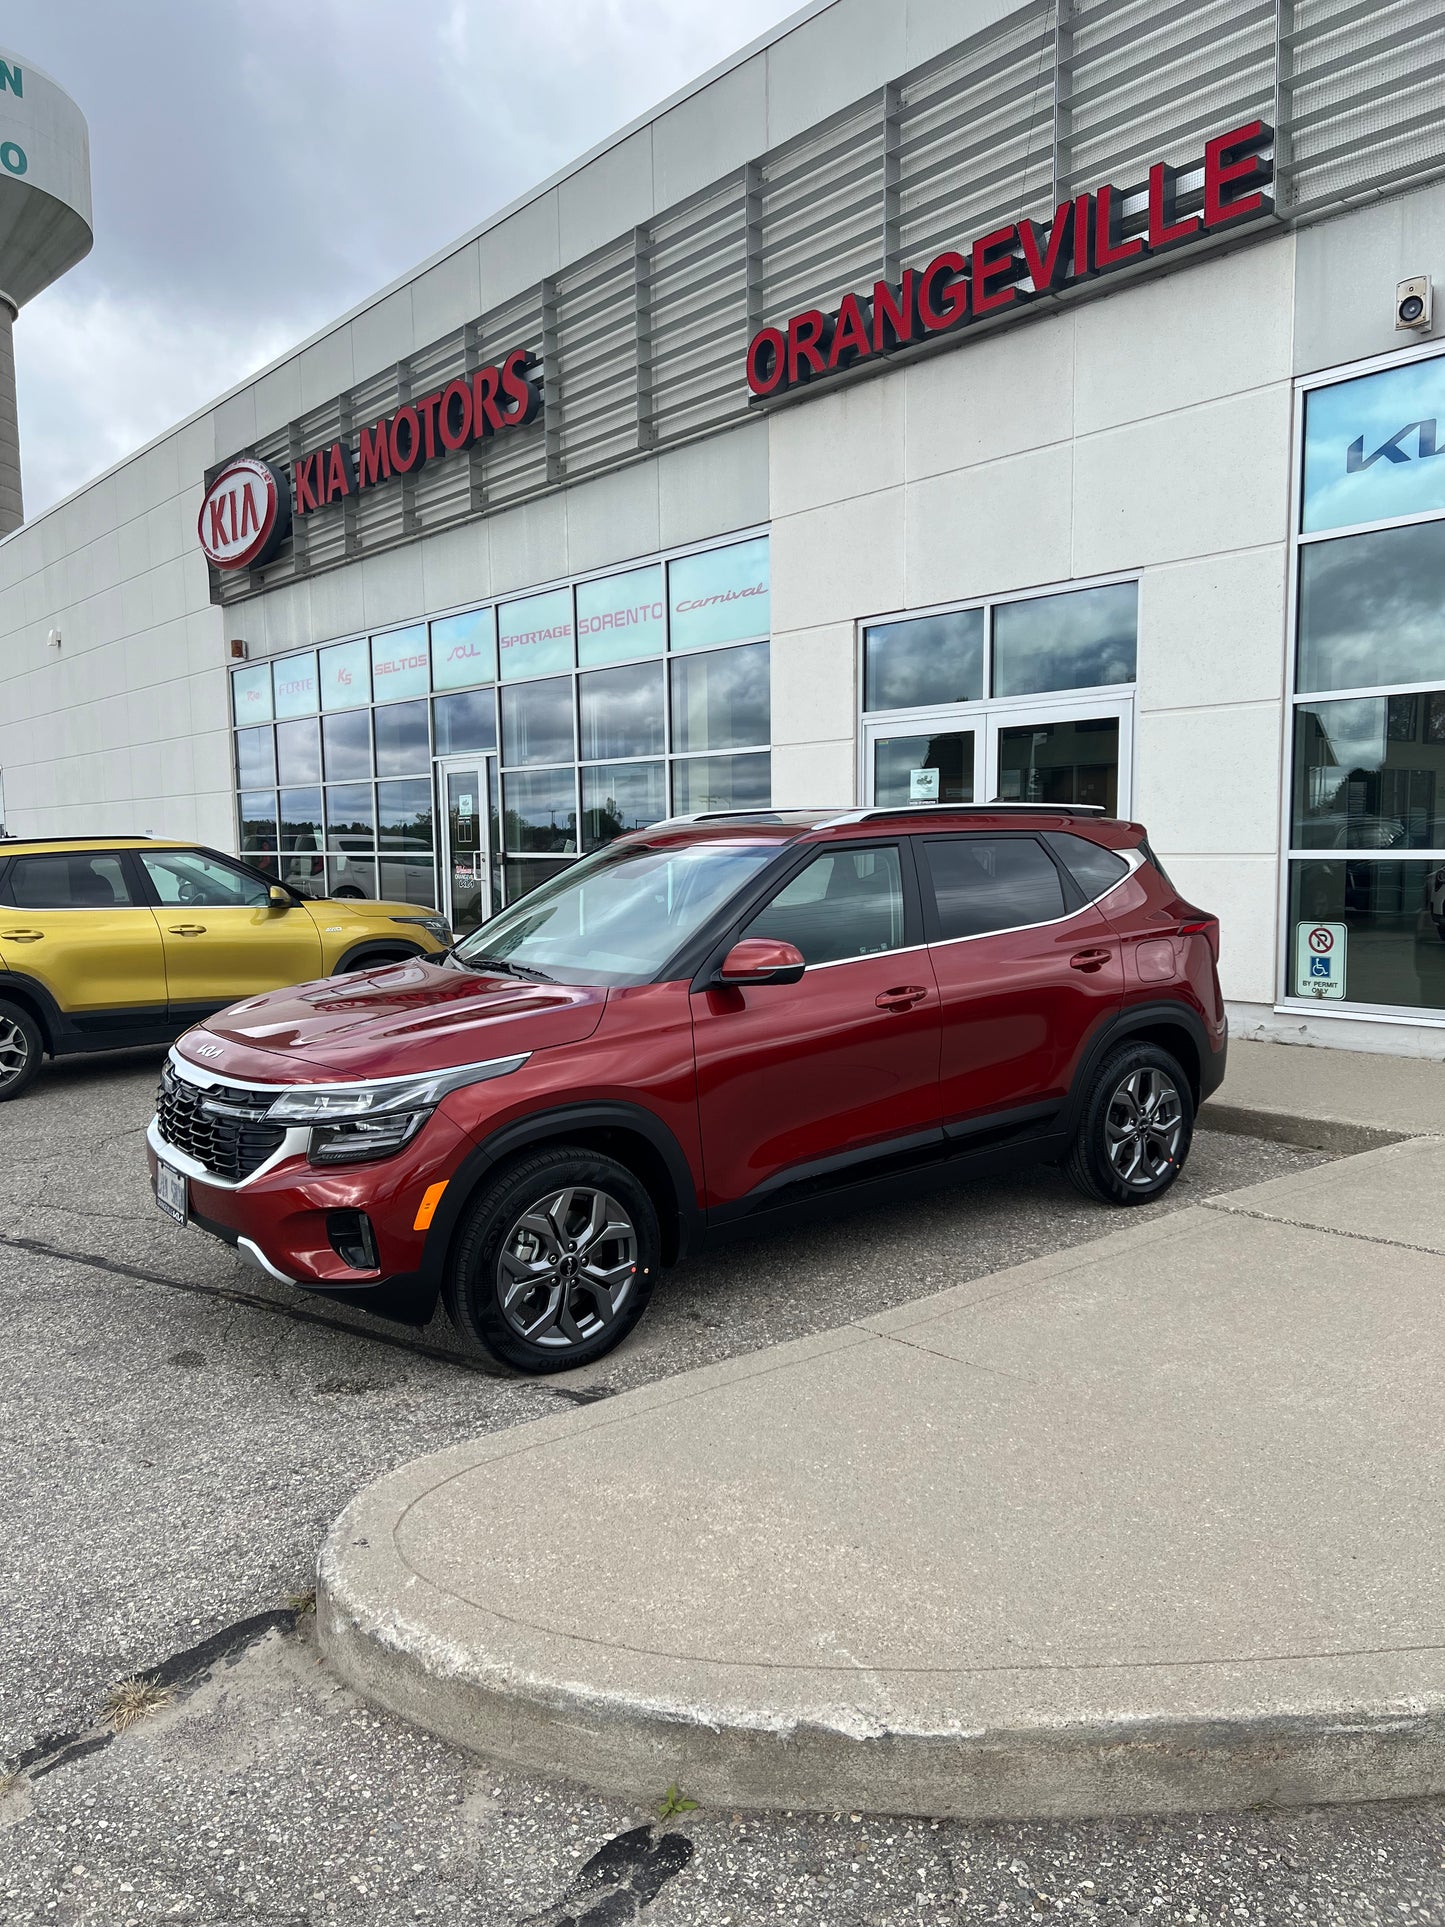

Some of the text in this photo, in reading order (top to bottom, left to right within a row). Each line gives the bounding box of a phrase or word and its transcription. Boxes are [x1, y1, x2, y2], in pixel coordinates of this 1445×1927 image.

[746, 119, 1264, 396] ORANGEVILLE
[295, 349, 536, 515] KIA MOTORS
[1346, 418, 1445, 474] KI
[209, 482, 260, 550] KIA
[675, 582, 769, 613] Carnival
[578, 602, 664, 635] SORENTO
[501, 624, 572, 649] SPORTAGE
[374, 654, 428, 676] SELTOS
[279, 678, 314, 696] FORTE
[196, 1044, 225, 1060] KIA
